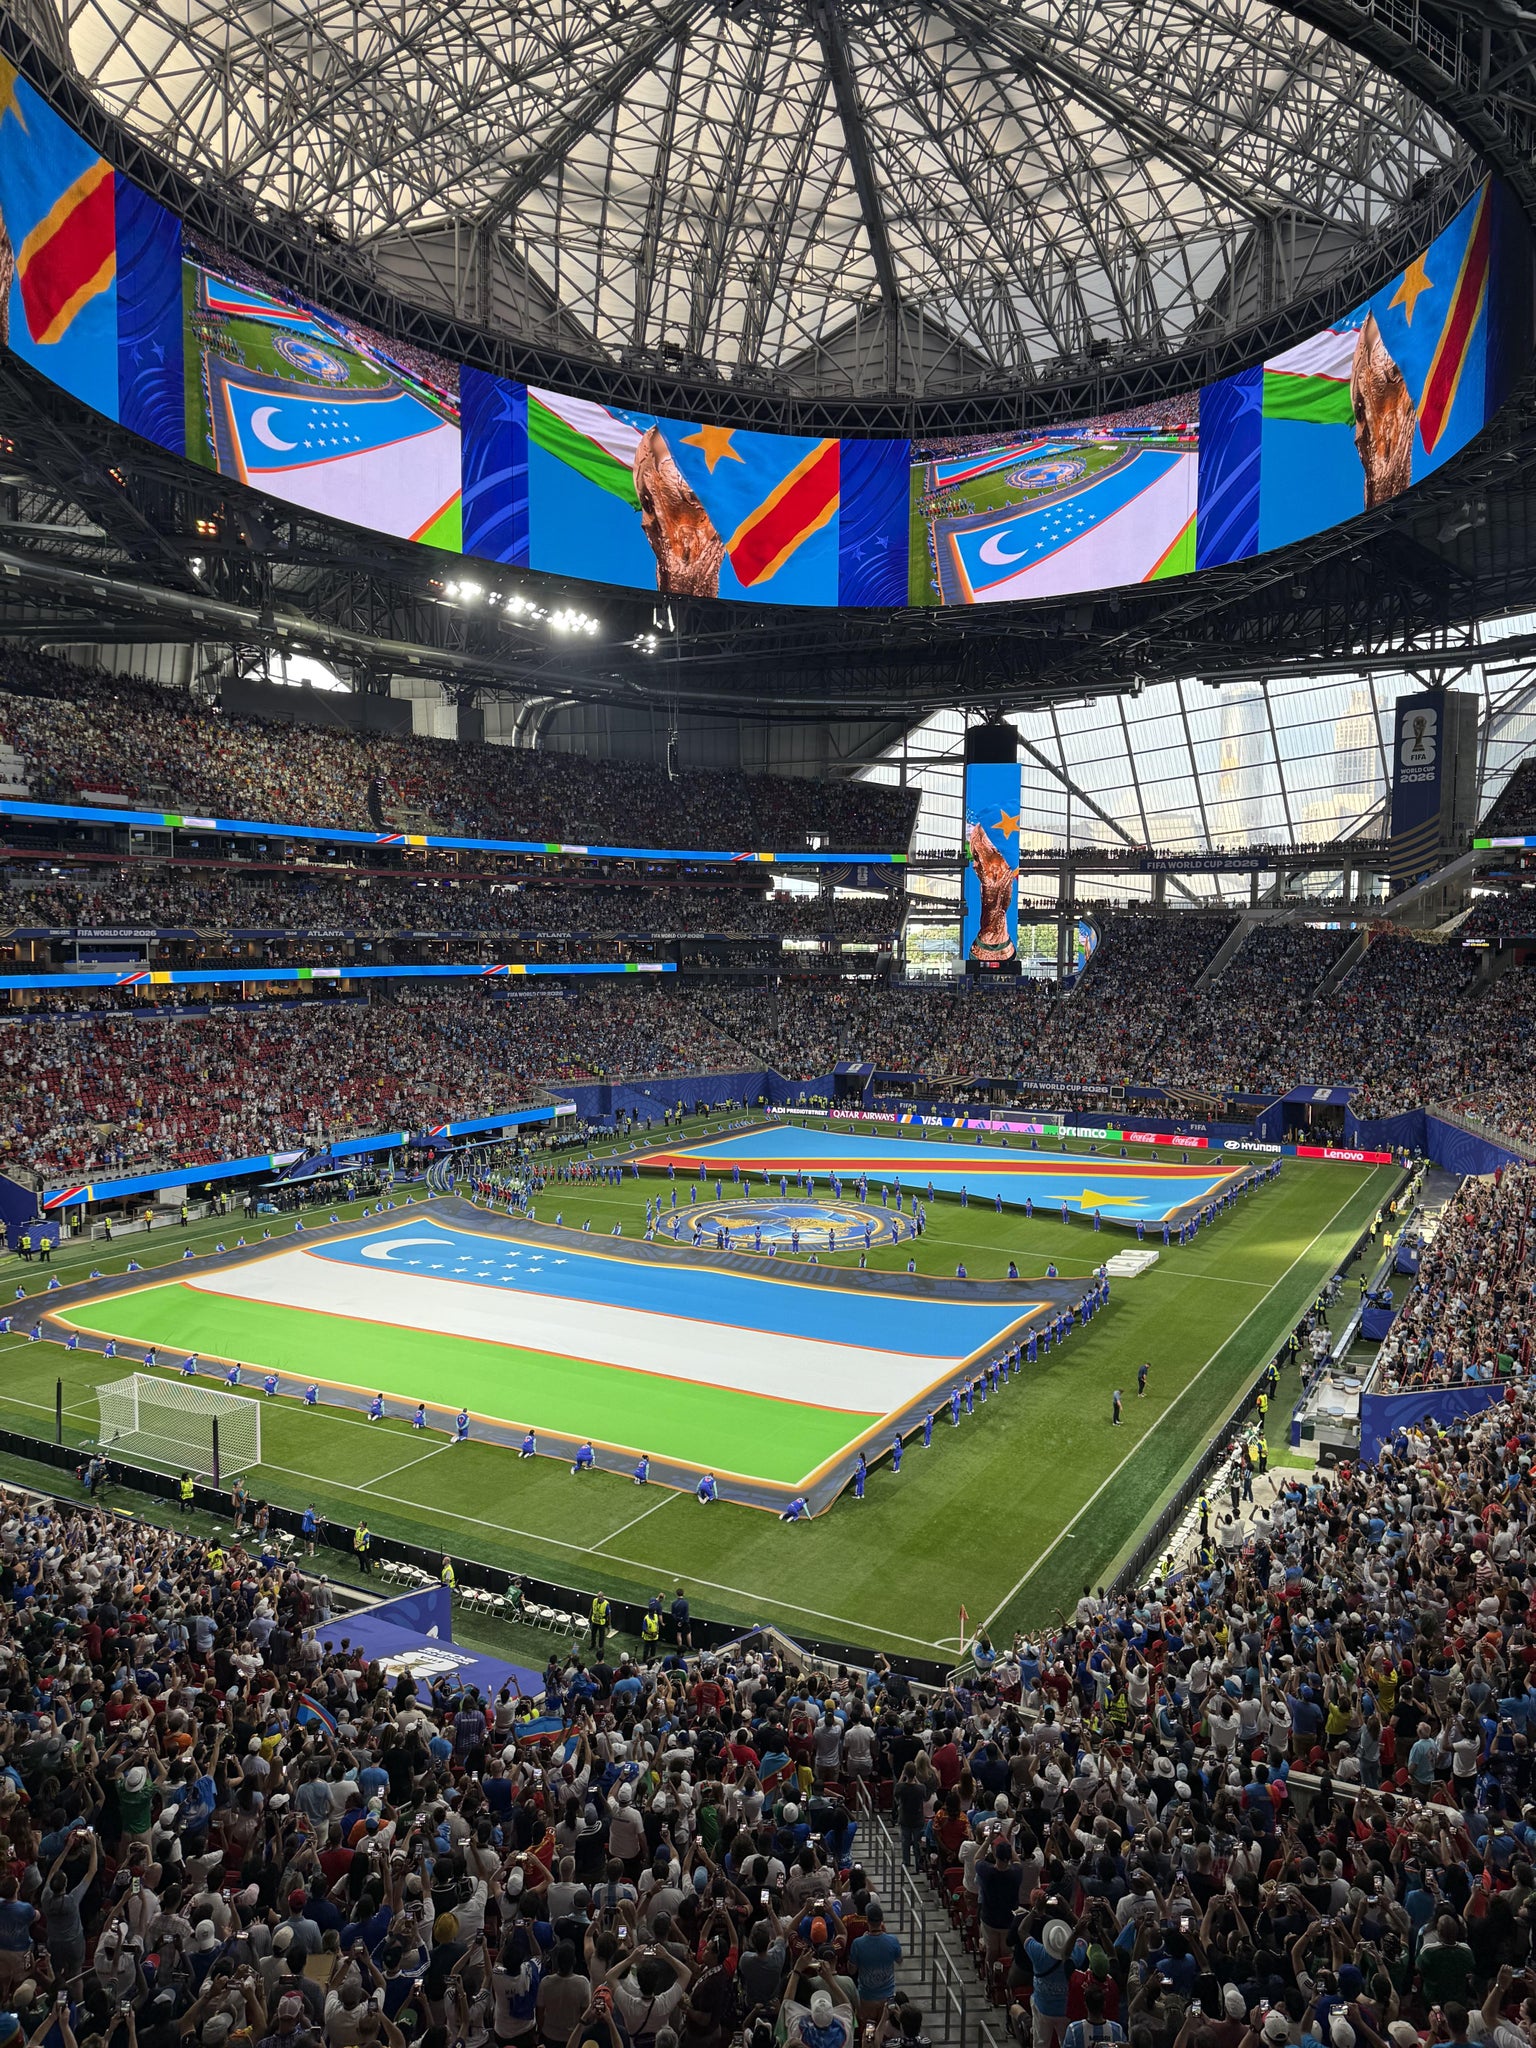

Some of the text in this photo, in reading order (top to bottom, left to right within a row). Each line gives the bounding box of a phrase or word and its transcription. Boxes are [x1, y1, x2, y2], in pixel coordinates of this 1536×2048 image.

[1400, 772, 1435, 783] 2026
[1168, 861, 1201, 869] WORLD
[1203, 860, 1223, 868] CUP
[1224, 860, 1259, 868] 2026
[1023, 1081, 1108, 1093] FIFA WORLD CUP 2026
[771, 1106, 786, 1114] ADI
[833, 1110, 895, 1122] QATAR AIRWAYS
[921, 1115, 943, 1126] VISA
[1059, 1126, 1107, 1138] aramco
[1190, 1123, 1207, 1131] FIFA
[1241, 1142, 1281, 1153] HYUNDAI
[1324, 1149, 1364, 1161] Lenovo
